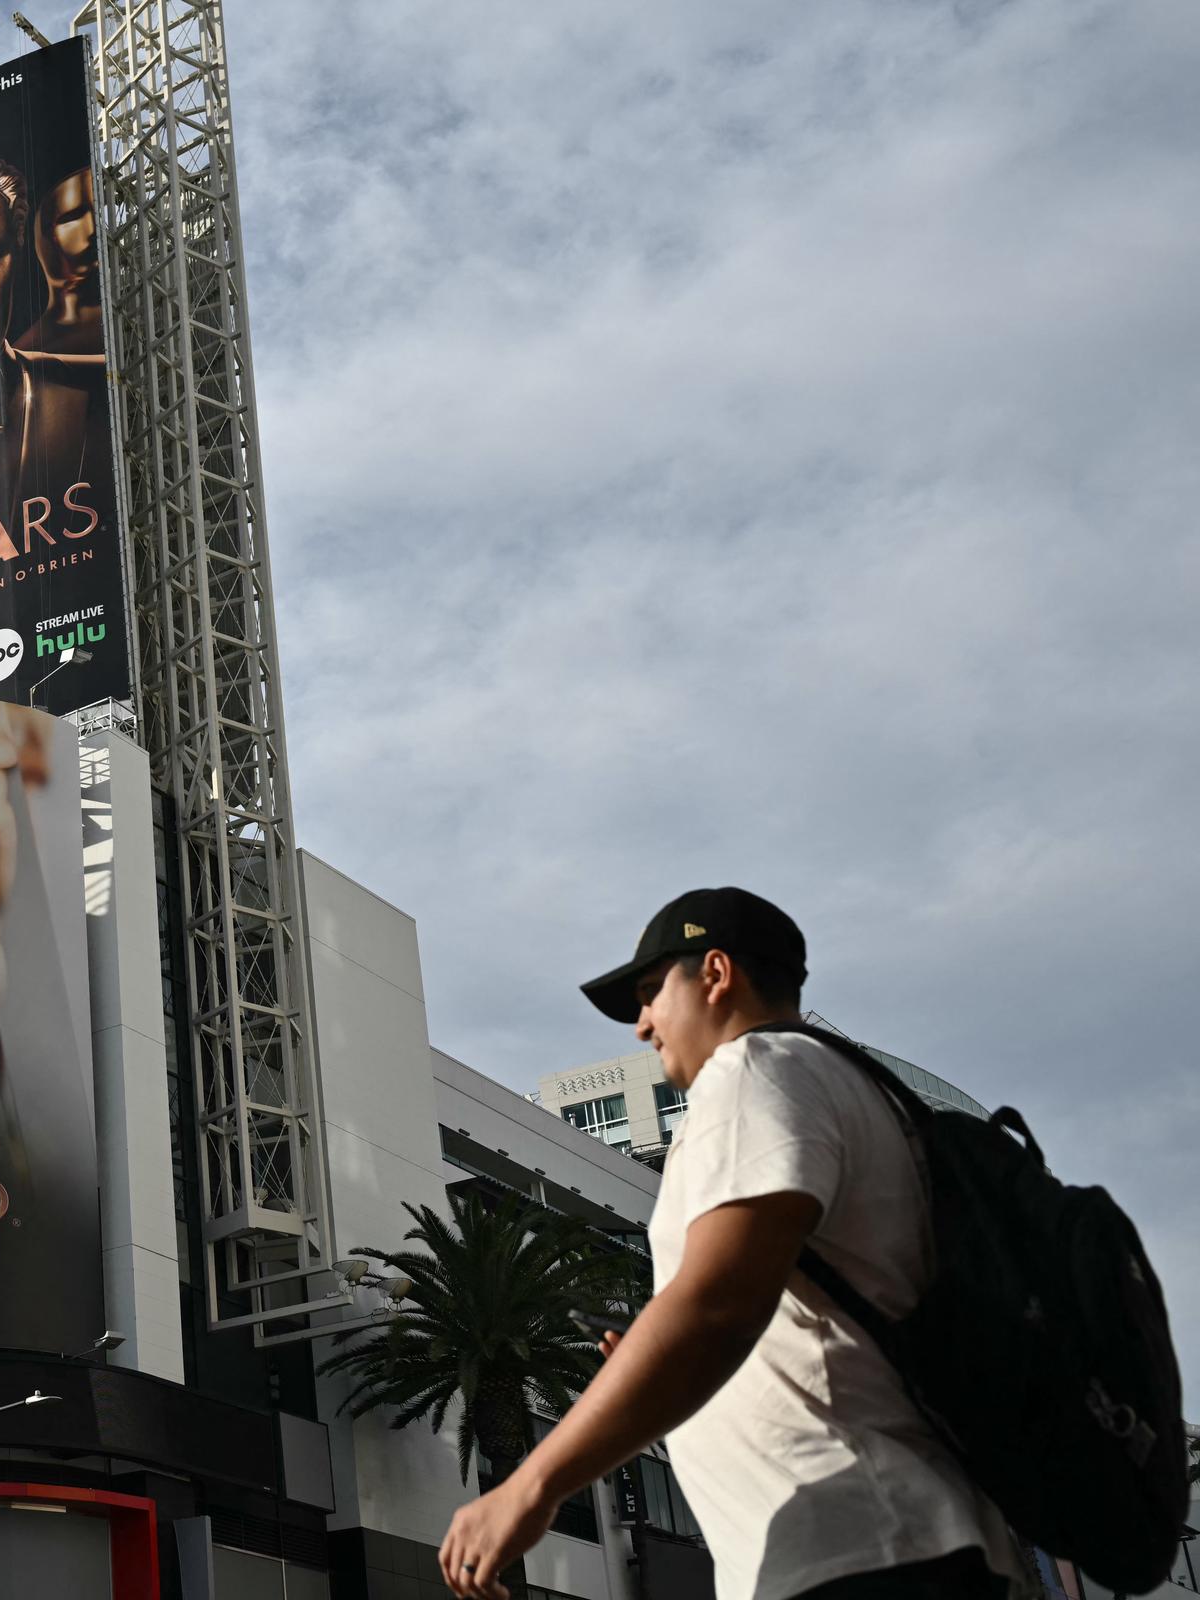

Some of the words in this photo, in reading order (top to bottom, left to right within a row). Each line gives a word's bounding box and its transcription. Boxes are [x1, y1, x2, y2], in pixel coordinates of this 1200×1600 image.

[14, 549, 94, 582] O'BRIEN
[35, 611, 80, 633] STREAM
[81, 604, 105, 622] LIVE
[36, 623, 106, 657] hulu
